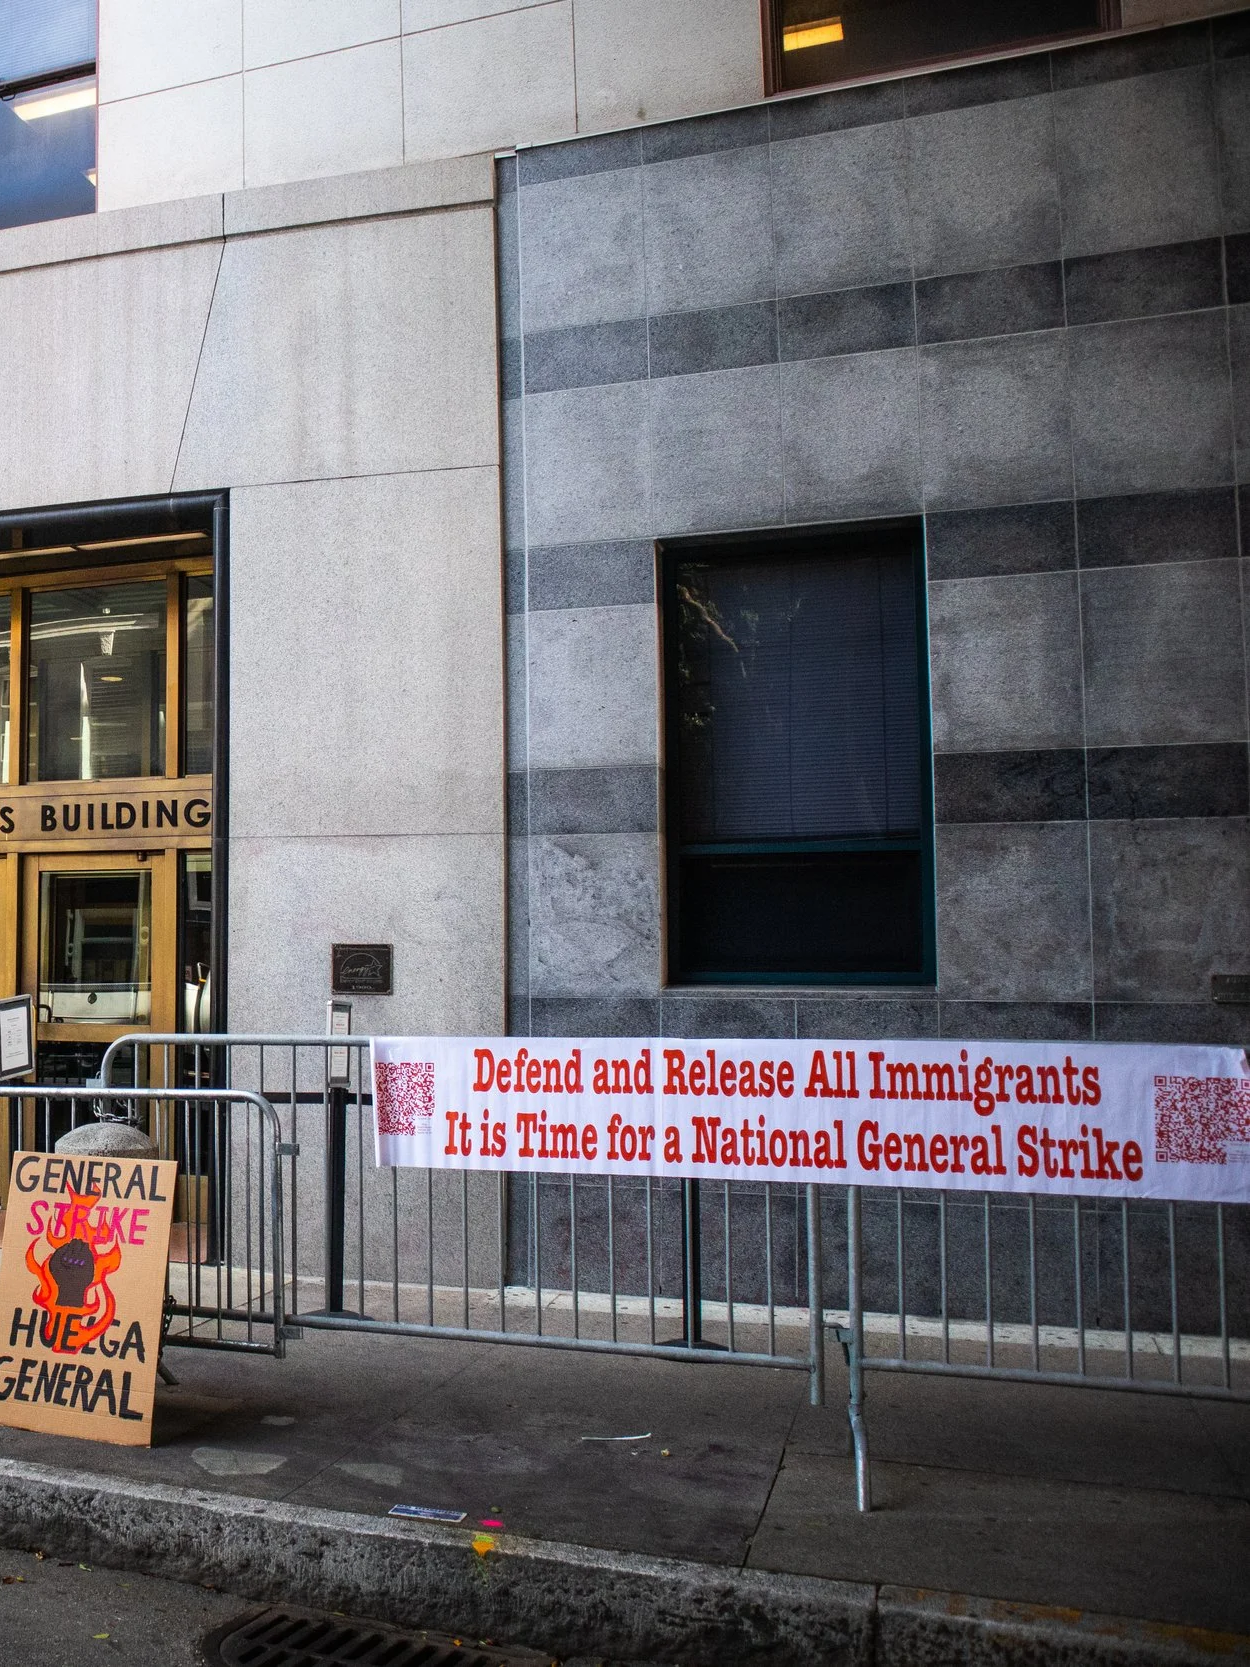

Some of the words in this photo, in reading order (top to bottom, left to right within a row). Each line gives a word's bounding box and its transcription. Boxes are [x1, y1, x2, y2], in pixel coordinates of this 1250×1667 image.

[40, 799, 212, 832] BUILDING
[472, 1047, 584, 1095] Defend
[593, 1047, 654, 1095] and
[662, 1048, 795, 1098] Release
[803, 1050, 860, 1099] All
[868, 1049, 1102, 1117] Immigrants
[444, 1110, 472, 1157] It
[479, 1108, 506, 1157] is
[516, 1109, 598, 1161] Time
[607, 1113, 655, 1162] for
[663, 1125, 683, 1164] a
[691, 1114, 847, 1168] National
[856, 1119, 1007, 1175] General
[1016, 1123, 1144, 1182] Strike
[15, 1155, 168, 1202] GENERAL
[25, 1200, 150, 1246] STRIKE
